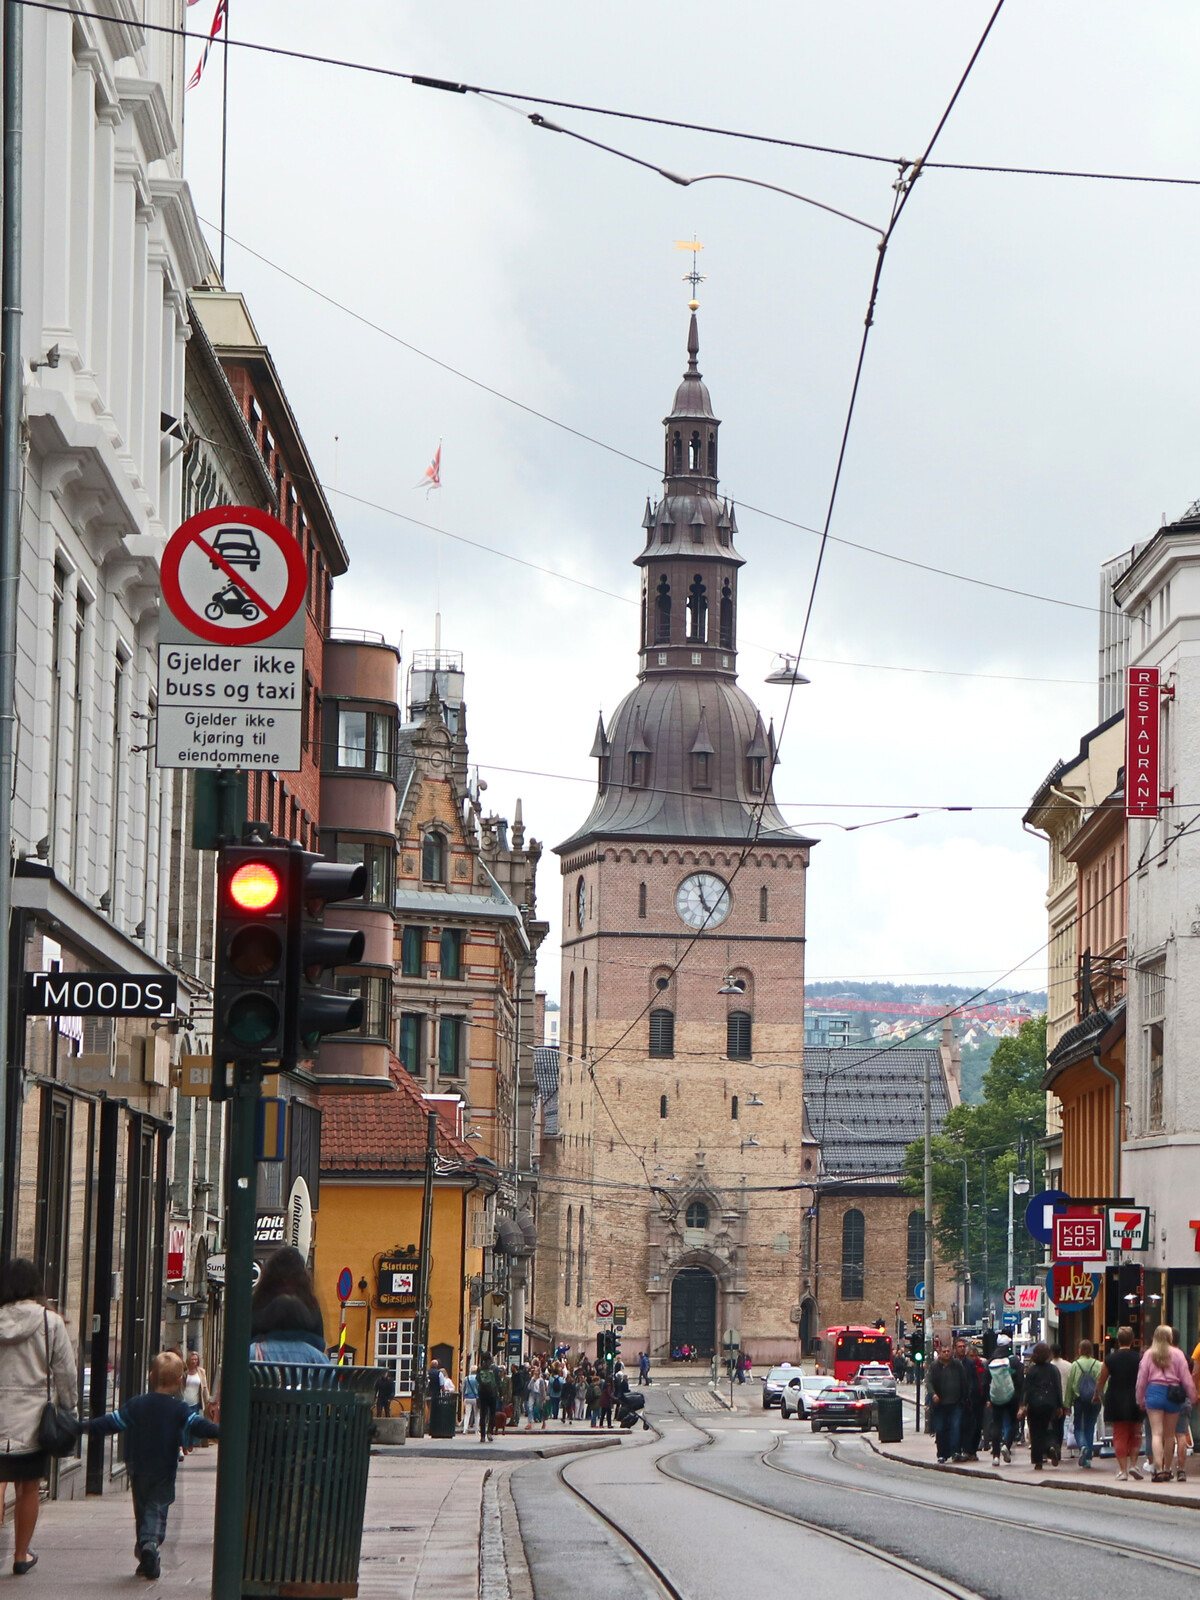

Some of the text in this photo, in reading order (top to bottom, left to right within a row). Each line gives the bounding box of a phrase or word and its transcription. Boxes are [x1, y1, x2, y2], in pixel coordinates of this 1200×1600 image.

[167, 652, 296, 674] Gjelder ikke
[166, 678, 296, 702] buss og taxi
[185, 711, 275, 728] Gjelder ikke
[193, 730, 266, 747] kjøring til
[1138, 672, 1150, 812] RESTAURANT
[178, 749, 280, 764] eiendommene
[44, 981, 164, 1010] MOODS
[1063, 1225, 1095, 1236] KOS
[1114, 1212, 1142, 1249] 7
[1018, 1289, 1039, 1302] H&M
[1059, 1285, 1092, 1302] JAZZ
